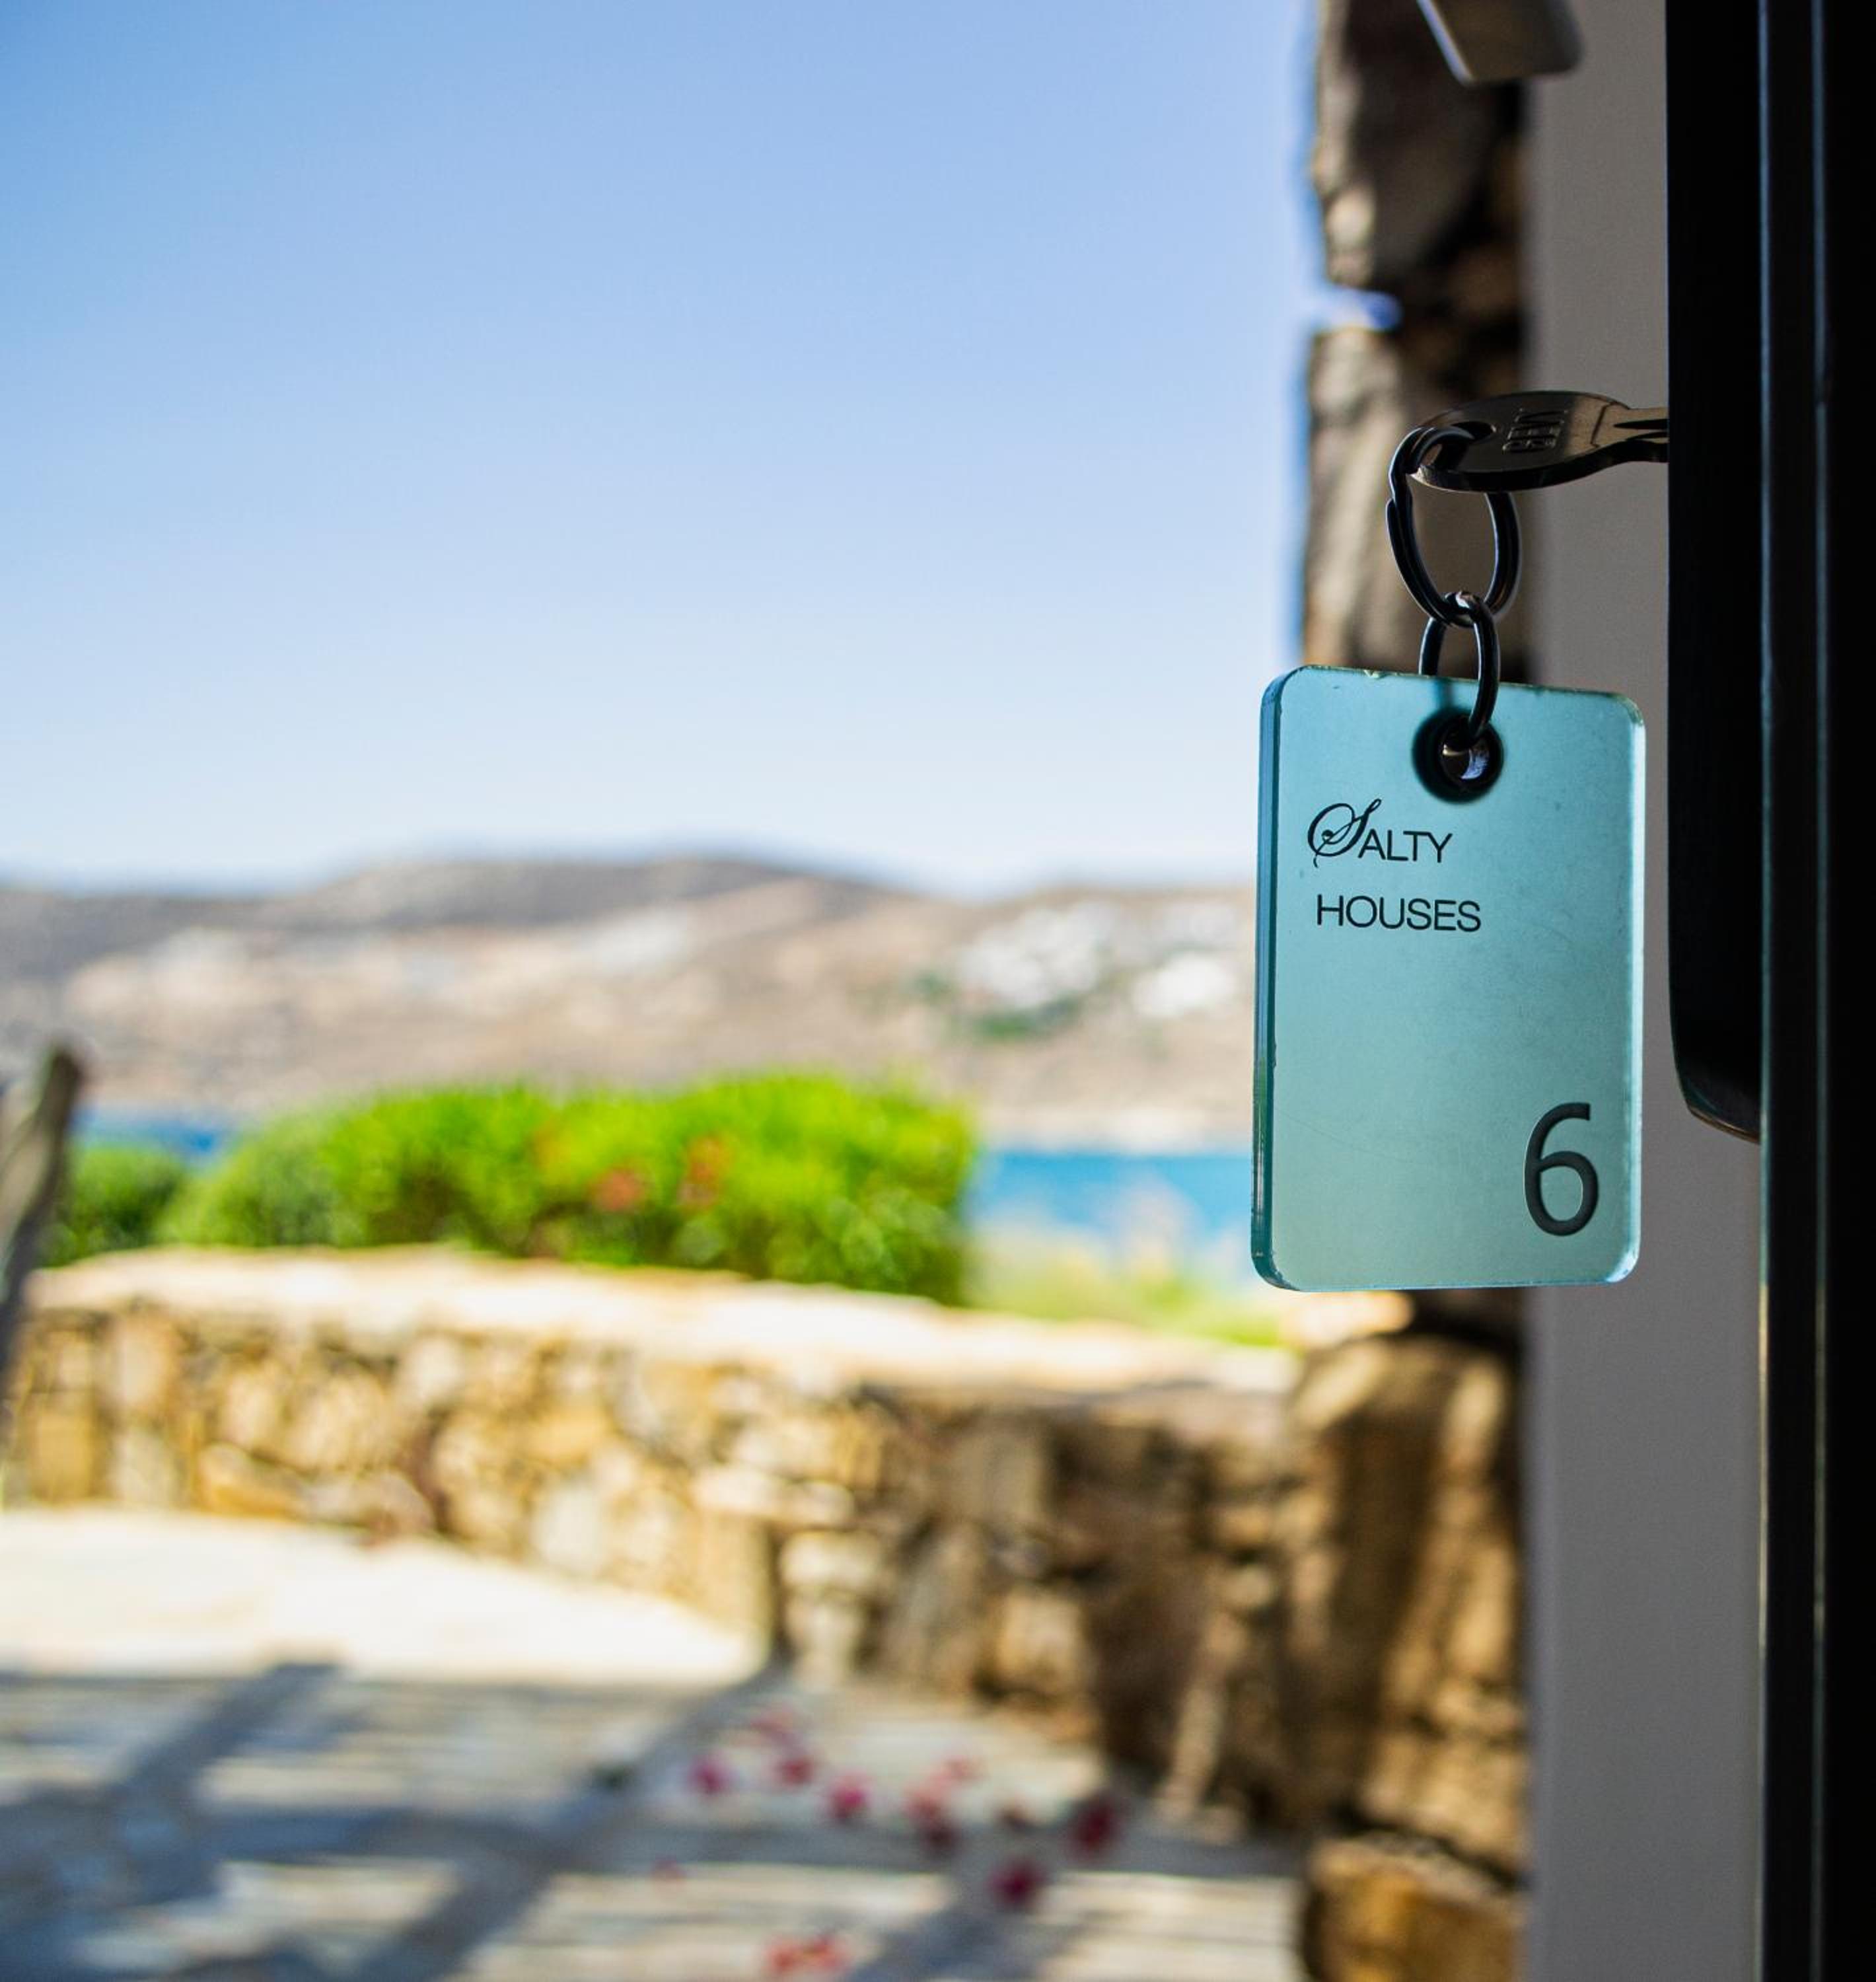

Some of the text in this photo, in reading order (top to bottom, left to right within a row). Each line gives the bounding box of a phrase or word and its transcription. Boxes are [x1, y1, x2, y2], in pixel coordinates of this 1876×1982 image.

[1307, 798, 1453, 868] SALTY
[1317, 894, 1481, 932] HOUSES
[1524, 1102, 1599, 1236] 6
